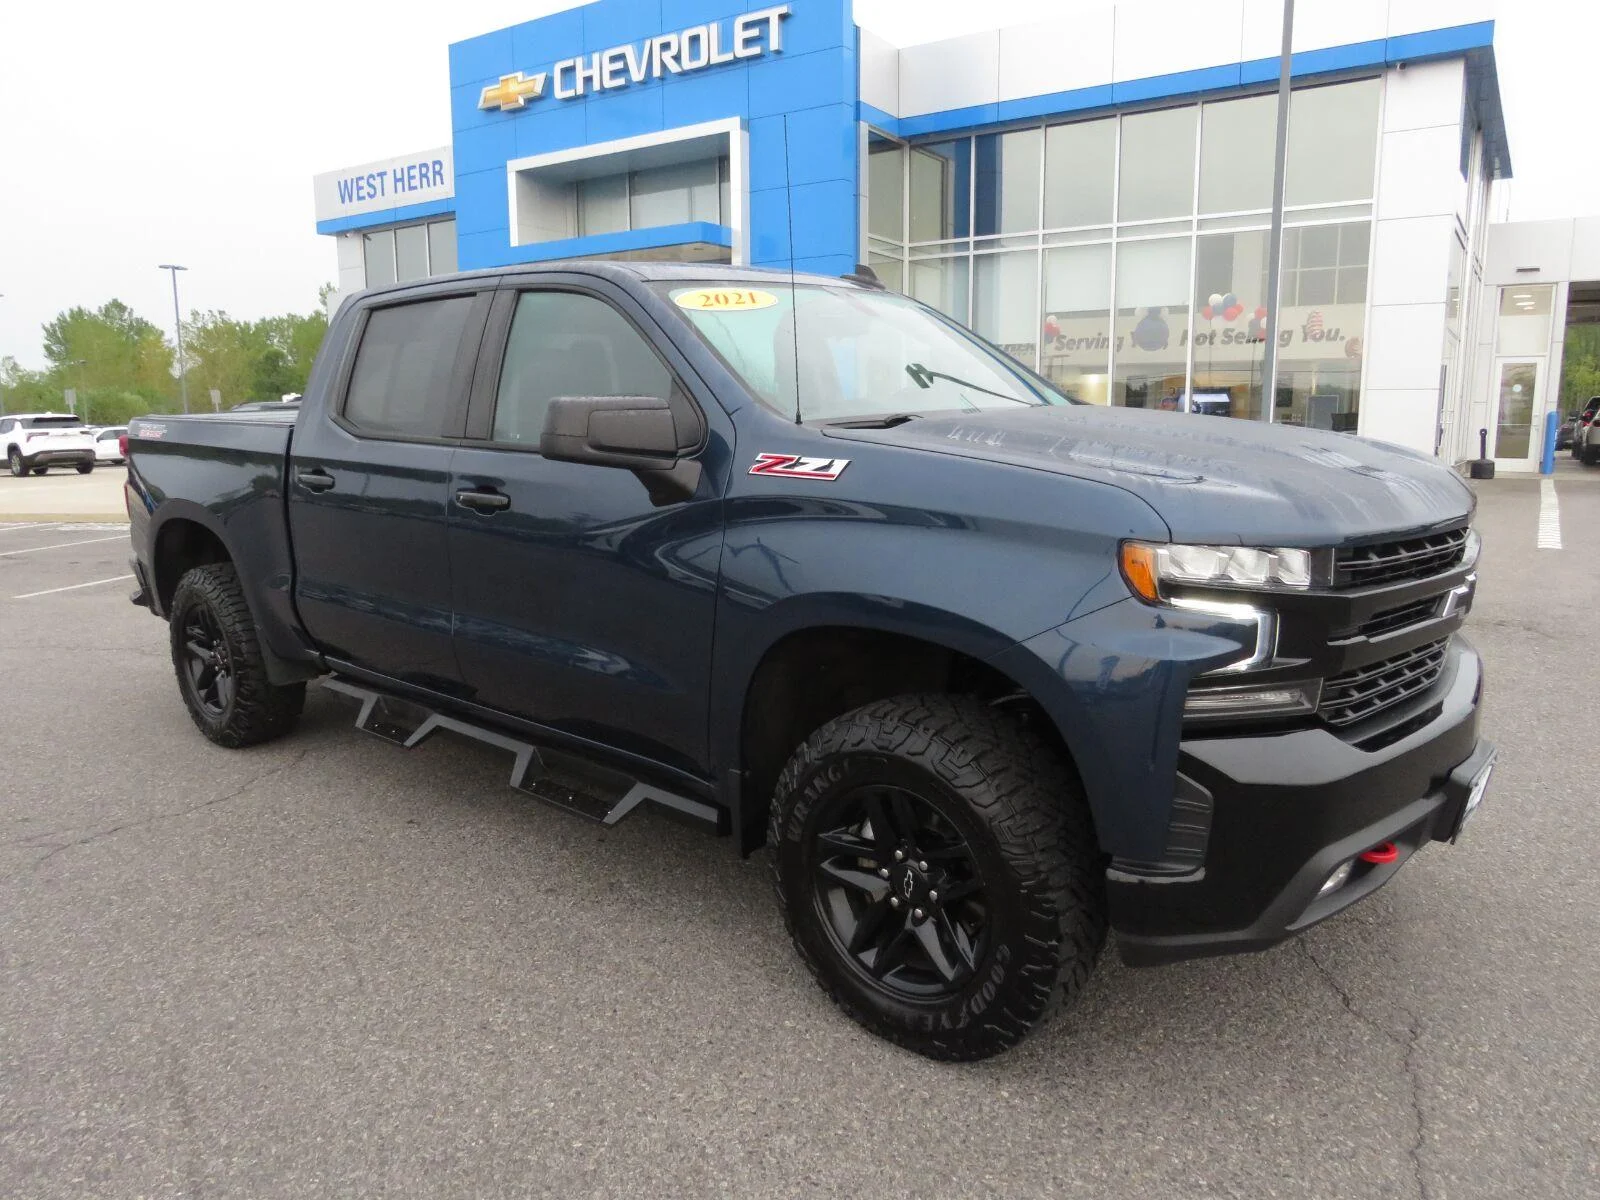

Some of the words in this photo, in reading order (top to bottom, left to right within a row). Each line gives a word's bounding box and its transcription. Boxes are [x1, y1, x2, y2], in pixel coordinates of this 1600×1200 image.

[553, 4, 791, 101] CHEVROLET
[337, 171, 388, 204] WEST
[393, 160, 445, 194] HERR
[699, 291, 758, 307] 2021
[747, 452, 852, 482] Z71
[900, 943, 1012, 1033] GOODYE
